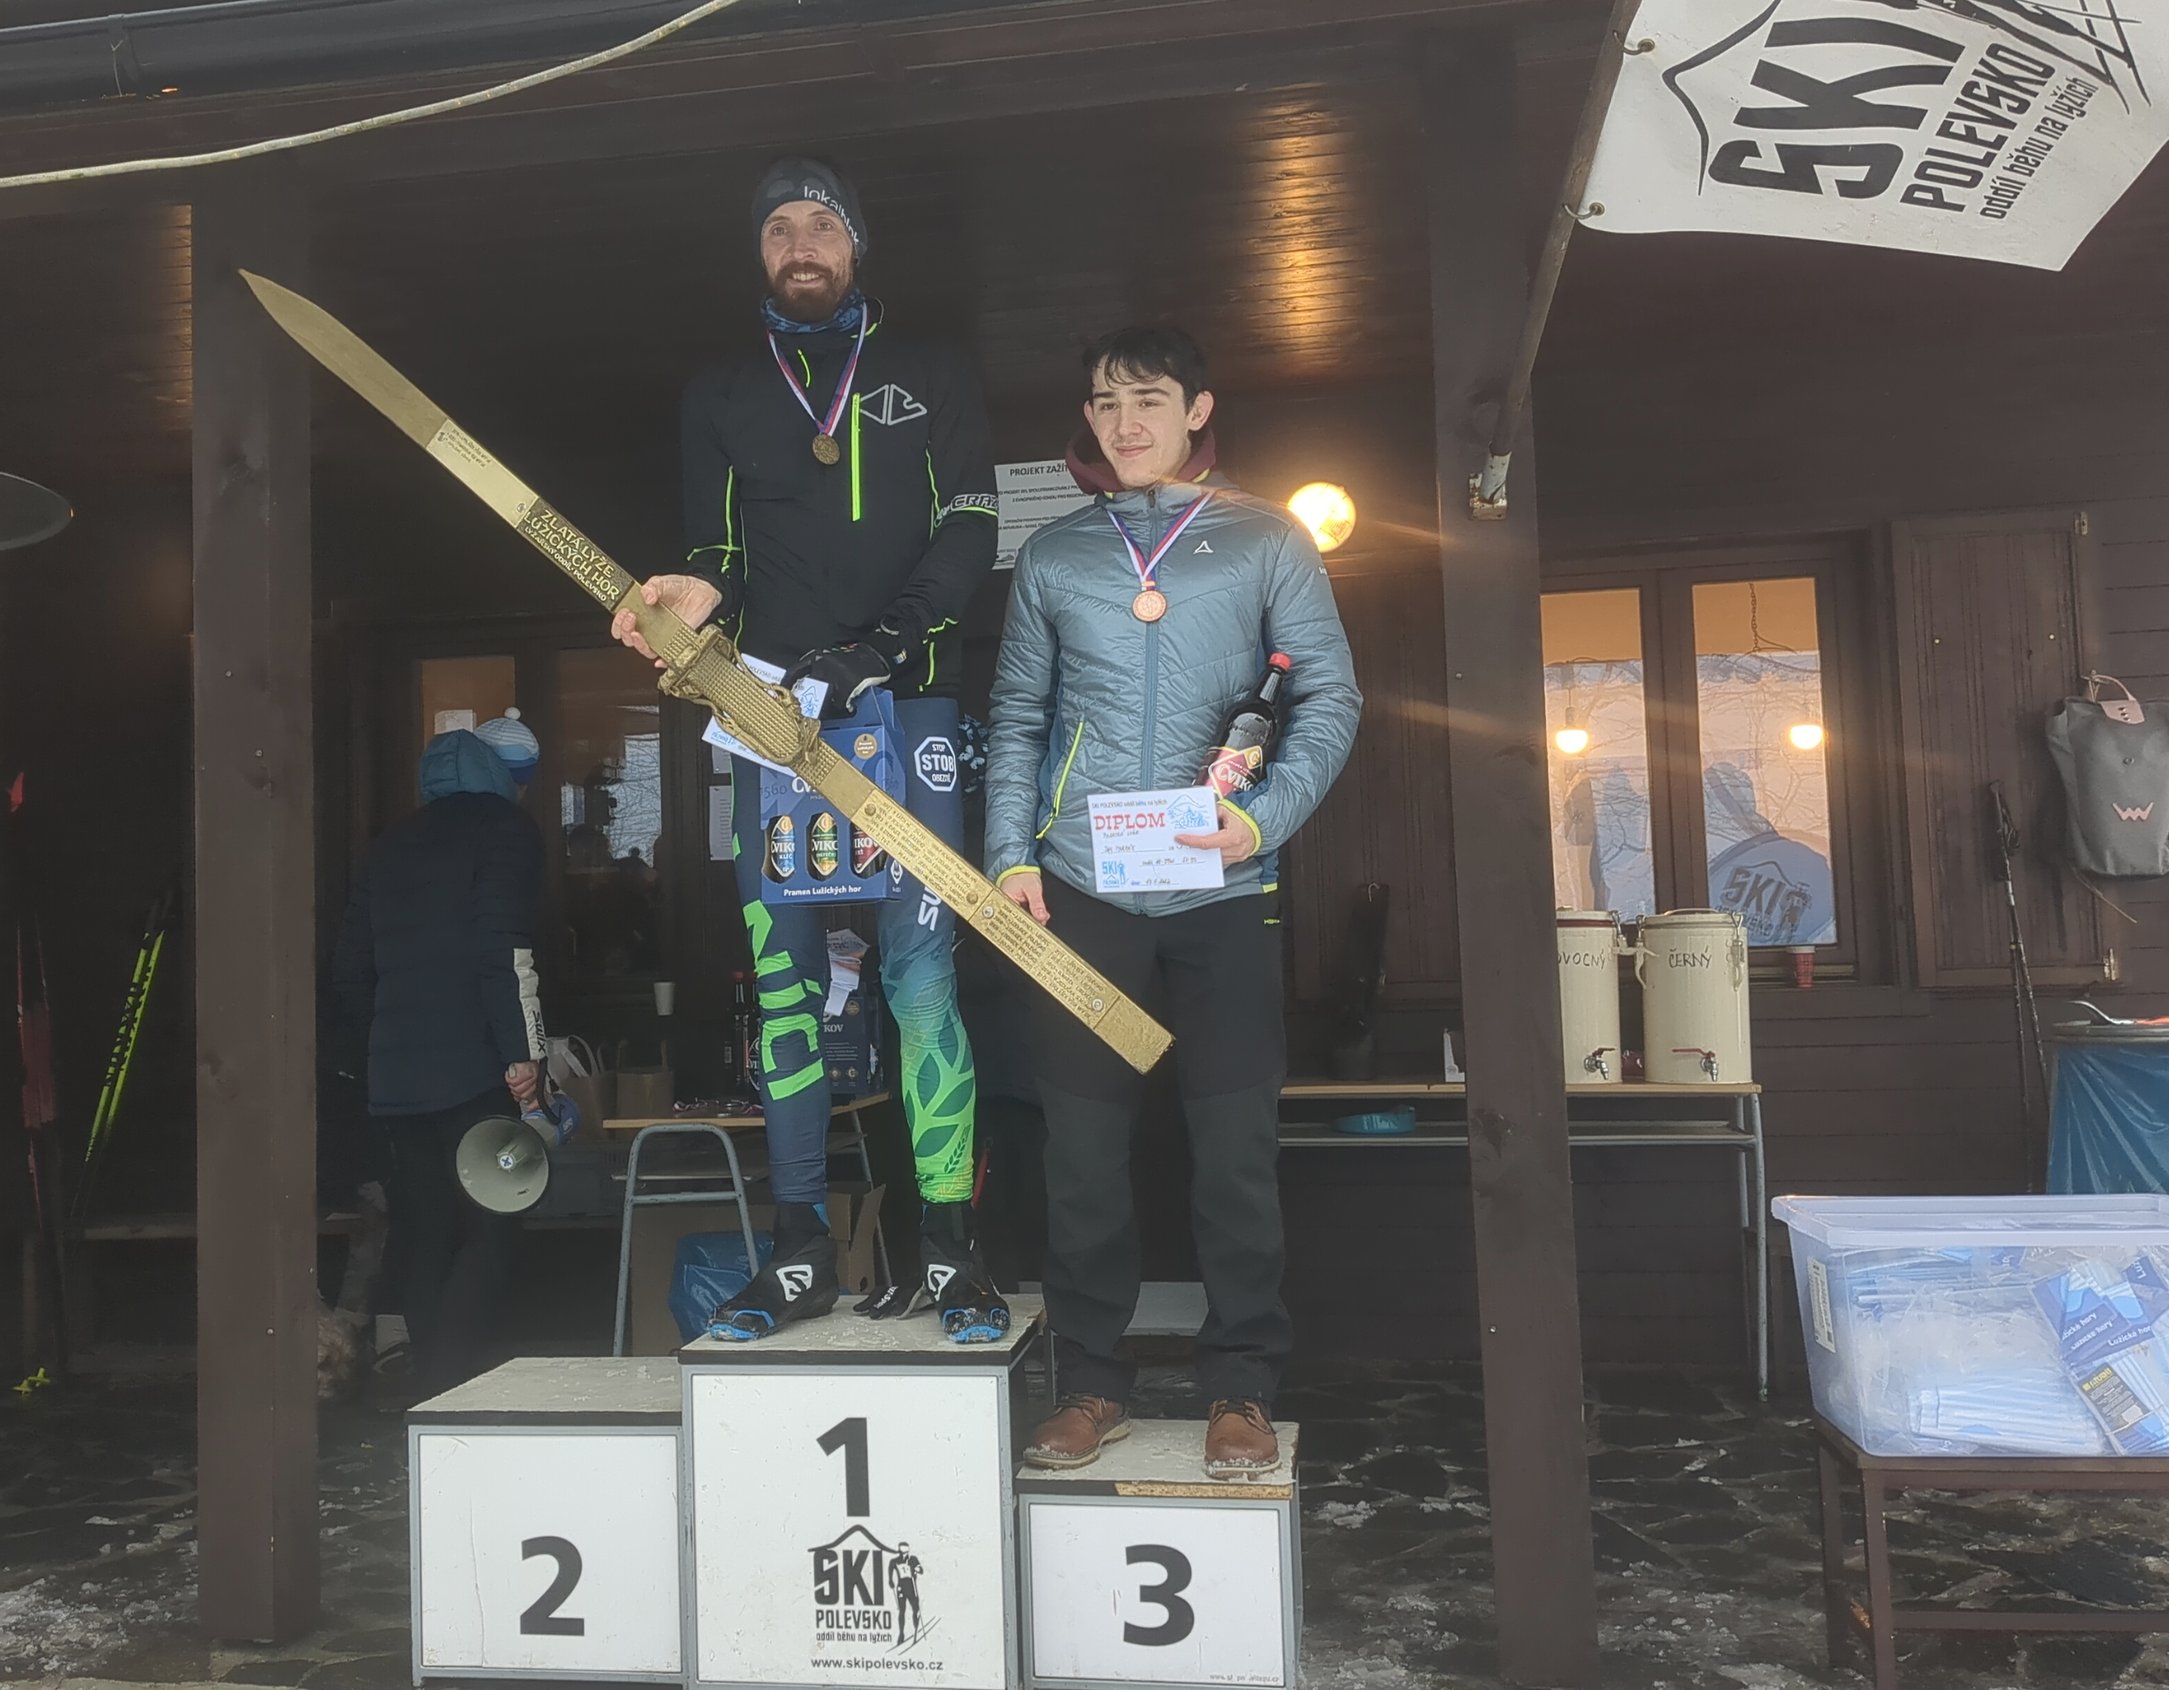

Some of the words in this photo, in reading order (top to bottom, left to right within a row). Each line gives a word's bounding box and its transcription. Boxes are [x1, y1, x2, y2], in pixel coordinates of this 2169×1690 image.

[1708, 17, 1966, 199] SKI
[2044, 77, 2099, 120] lyžích
[1900, 43, 2056, 213] POLEVSKO
[2034, 116, 2069, 140] na
[2002, 136, 2054, 178] běhu
[1980, 175, 2027, 219] oddíl
[1010, 467, 1044, 477] PROJEKT
[524, 511, 593, 576] LUŽICKÝCH
[591, 571, 620, 600] HOR
[540, 509, 584, 550] ZLATÁ
[581, 541, 615, 578] LYŽE
[921, 754, 954, 772] STOB
[1094, 812, 1165, 830] DIPLOM
[783, 888, 811, 896] Pramen
[812, 885, 847, 895] Lužických
[848, 885, 861, 893] hor
[1721, 866, 1787, 915] SKI
[1668, 946, 1713, 968] ČERNÝ
[816, 1417, 871, 1517] 1
[519, 1536, 585, 1636] 2
[813, 1549, 884, 1606] SKI
[1123, 1544, 1195, 1648] 3
[815, 1609, 891, 1629] POLEVSKO
[816, 1632, 835, 1642] oddíl
[837, 1631, 855, 1642] běhu
[857, 1634, 867, 1642] na
[869, 1631, 892, 1644] lyžích
[811, 1658, 944, 1671] www.skipolevsko.cz
